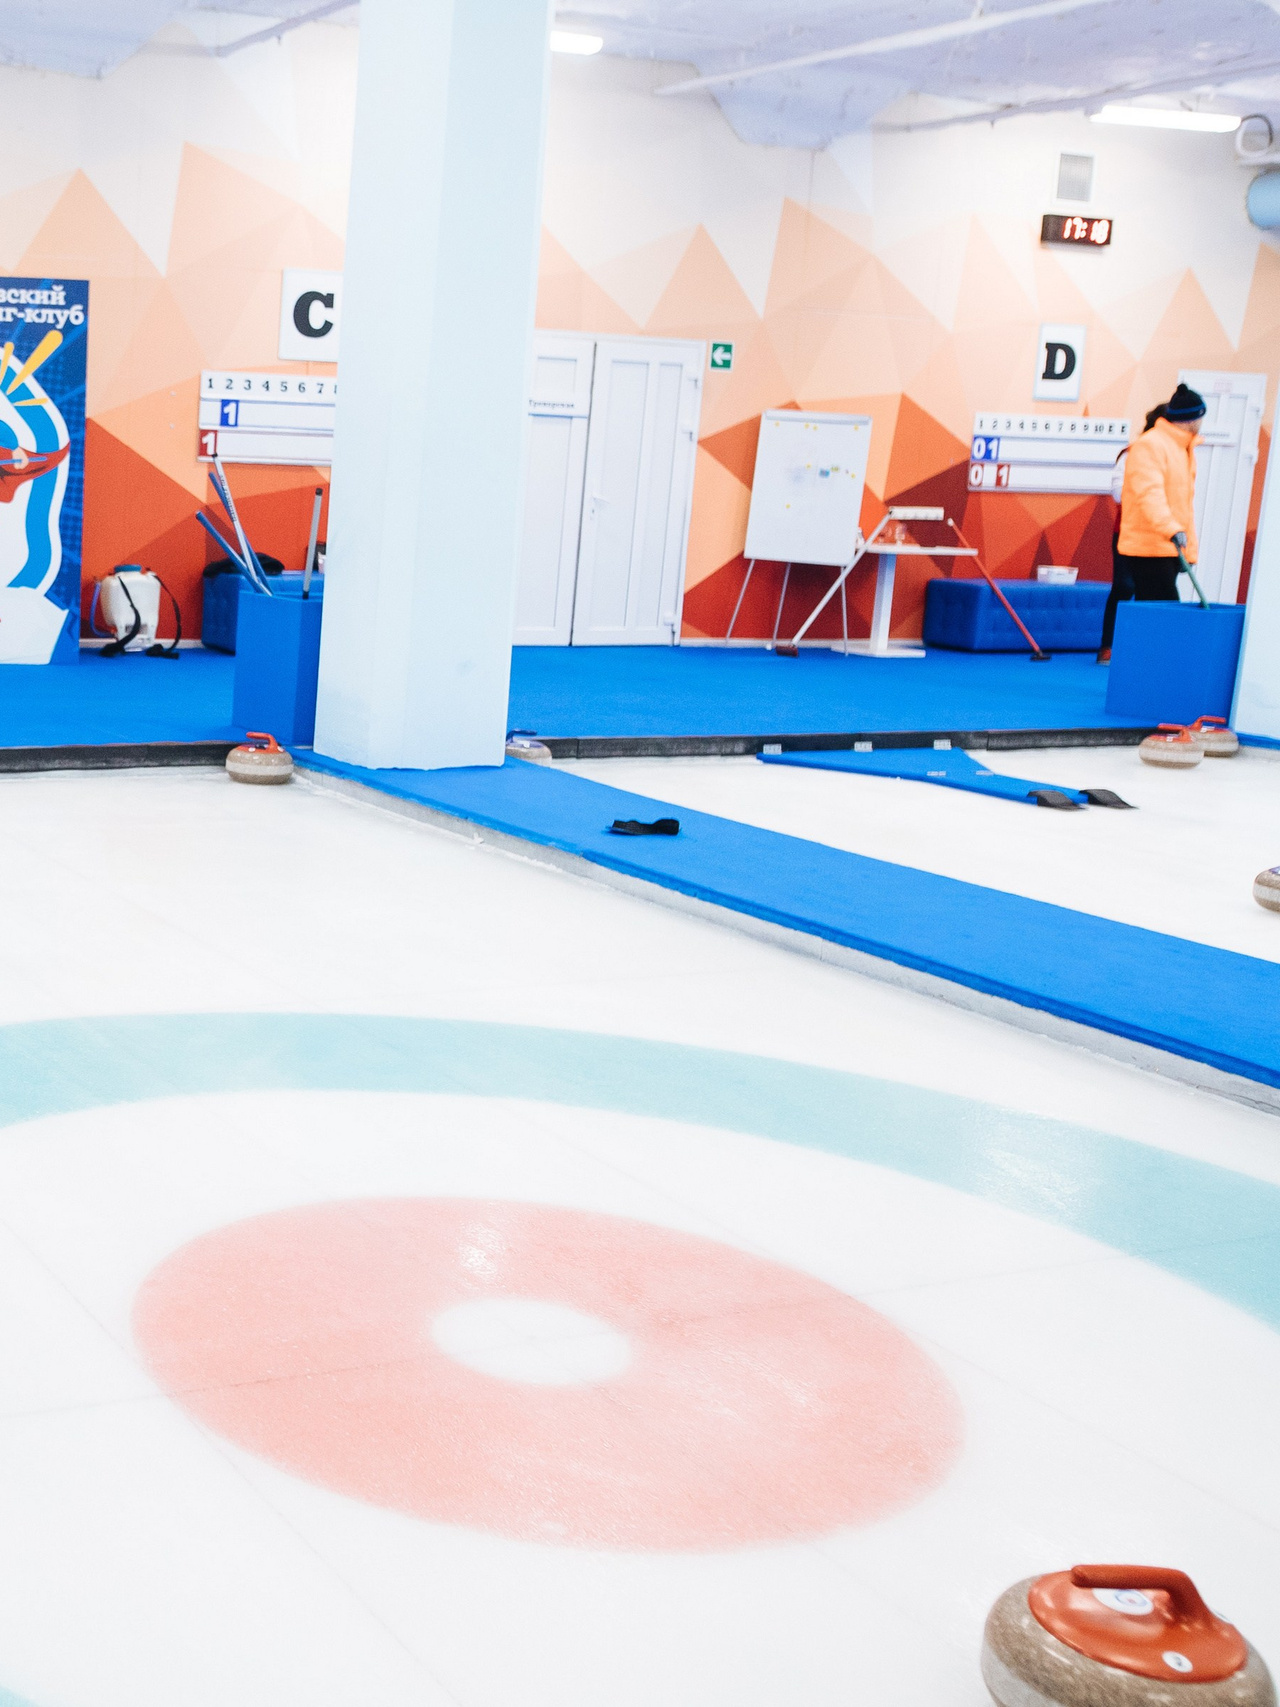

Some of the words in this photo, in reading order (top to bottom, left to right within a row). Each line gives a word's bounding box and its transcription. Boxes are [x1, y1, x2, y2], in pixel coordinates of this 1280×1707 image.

[293, 290, 335, 338] C
[1041, 342, 1076, 380] D
[225, 378, 234, 391] 2
[243, 379, 252, 391] 3
[261, 380, 270, 392] 4
[280, 380, 288, 393] 5
[297, 381, 306, 394] 6
[316, 382, 325, 395] 7
[223, 401, 238, 427] 1
[202, 432, 216, 456] 1
